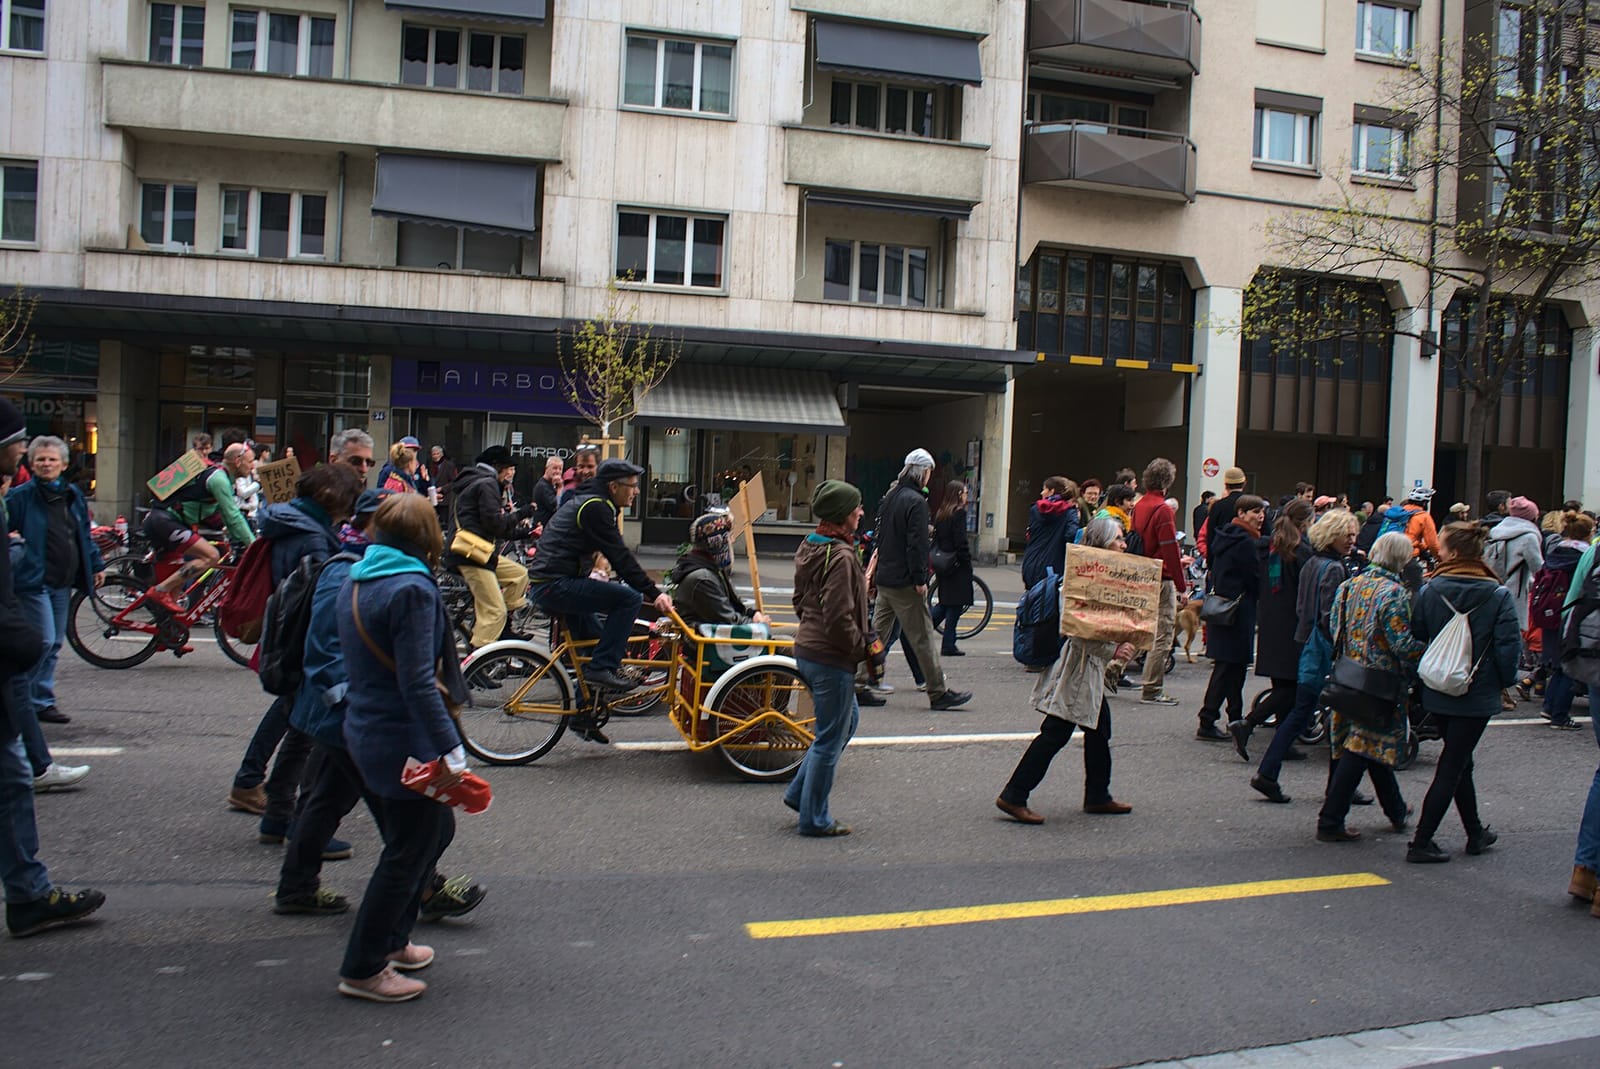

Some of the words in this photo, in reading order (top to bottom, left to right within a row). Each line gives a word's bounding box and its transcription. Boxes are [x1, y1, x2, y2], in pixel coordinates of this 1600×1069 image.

[511, 446, 577, 460] HAIRBOX
[261, 463, 295, 482] THIS
[269, 480, 282, 493] IS
[186, 577, 232, 620] TREK
